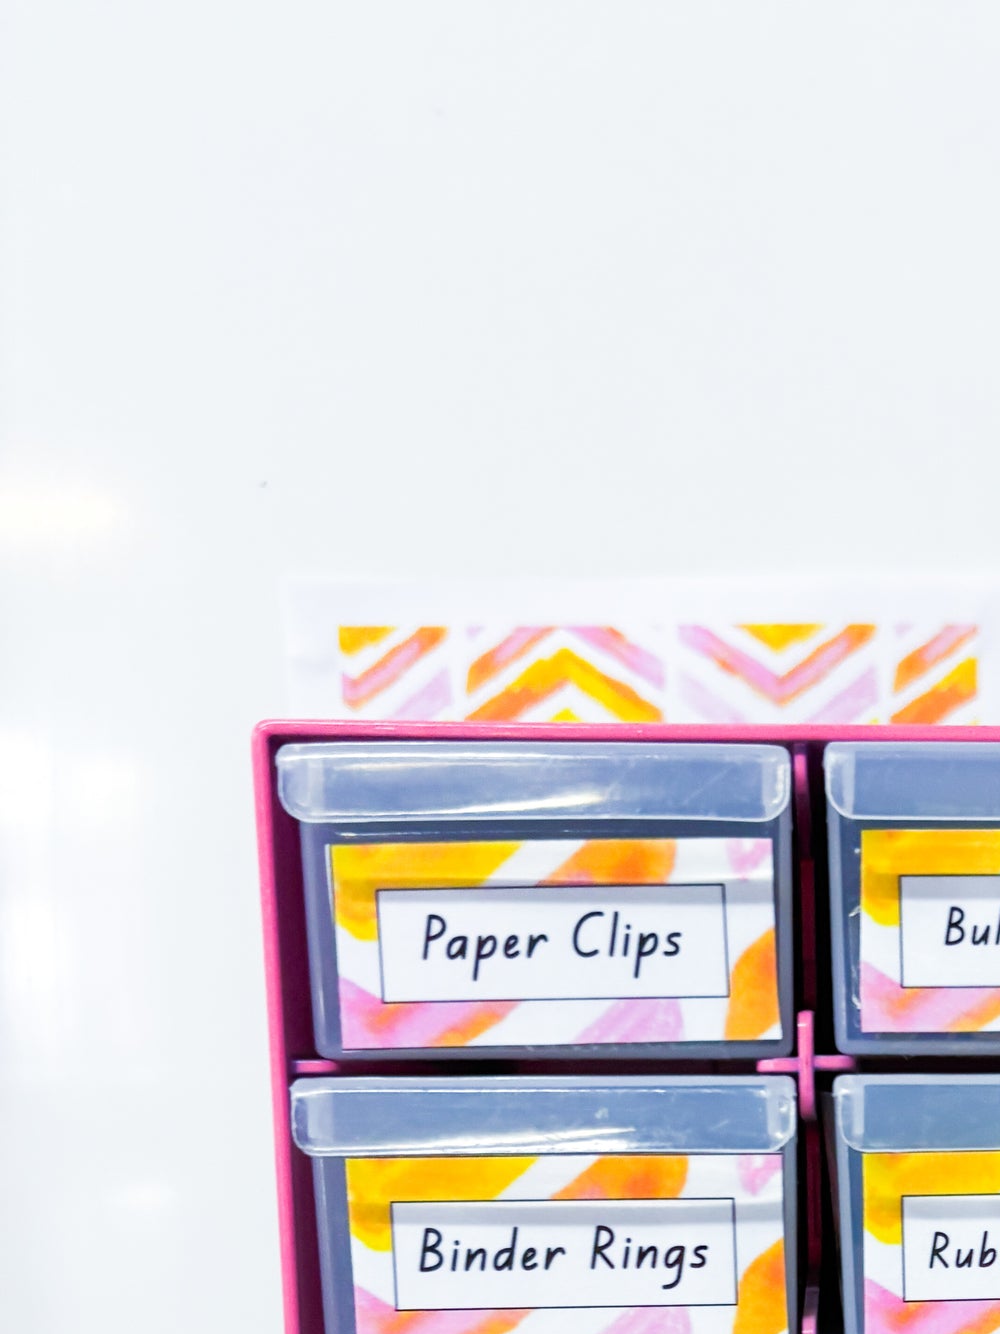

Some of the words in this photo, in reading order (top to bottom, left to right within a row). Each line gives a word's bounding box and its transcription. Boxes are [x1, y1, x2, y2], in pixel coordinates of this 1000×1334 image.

[422, 913, 549, 982] Paper
[572, 911, 682, 979] Clips
[419, 1226, 566, 1273] Binder
[590, 1224, 709, 1290] Rings
